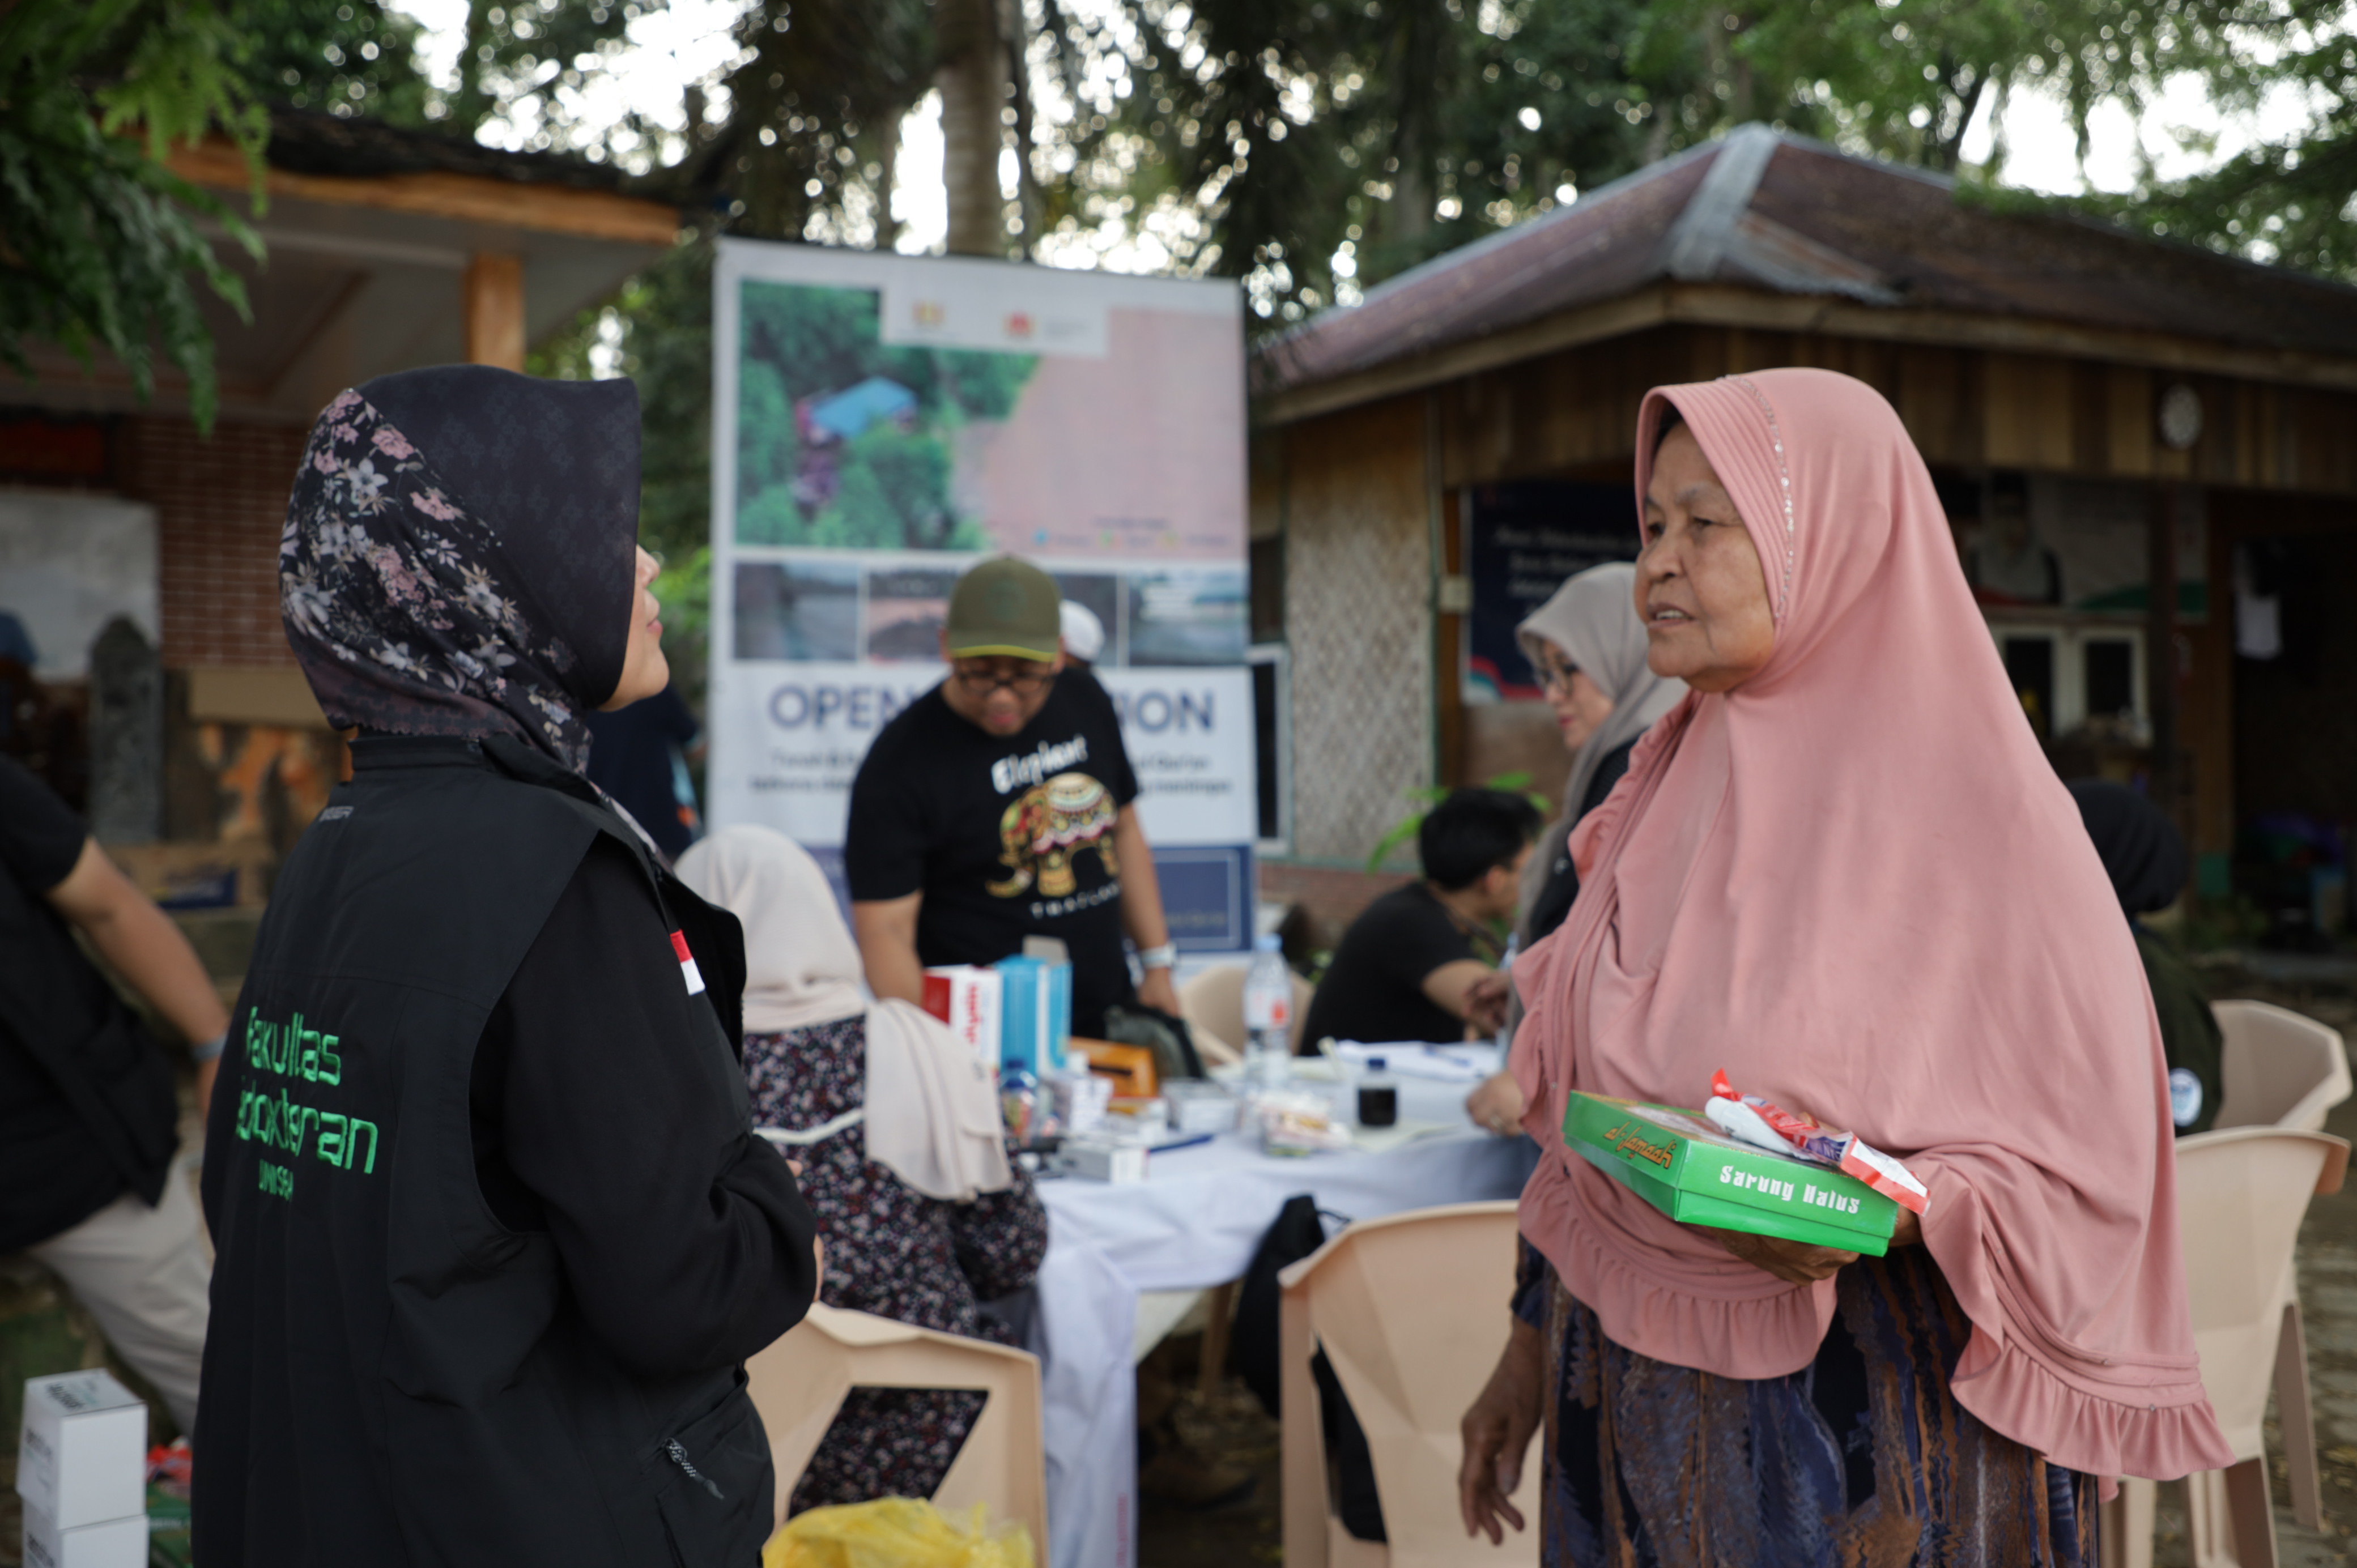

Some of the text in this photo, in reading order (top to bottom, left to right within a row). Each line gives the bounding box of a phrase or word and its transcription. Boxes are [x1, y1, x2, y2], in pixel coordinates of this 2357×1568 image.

[770, 683, 914, 729] OPEN
[1030, 880, 1121, 919] THAILAN
[1720, 1165, 1861, 1215] Sarung Halus
